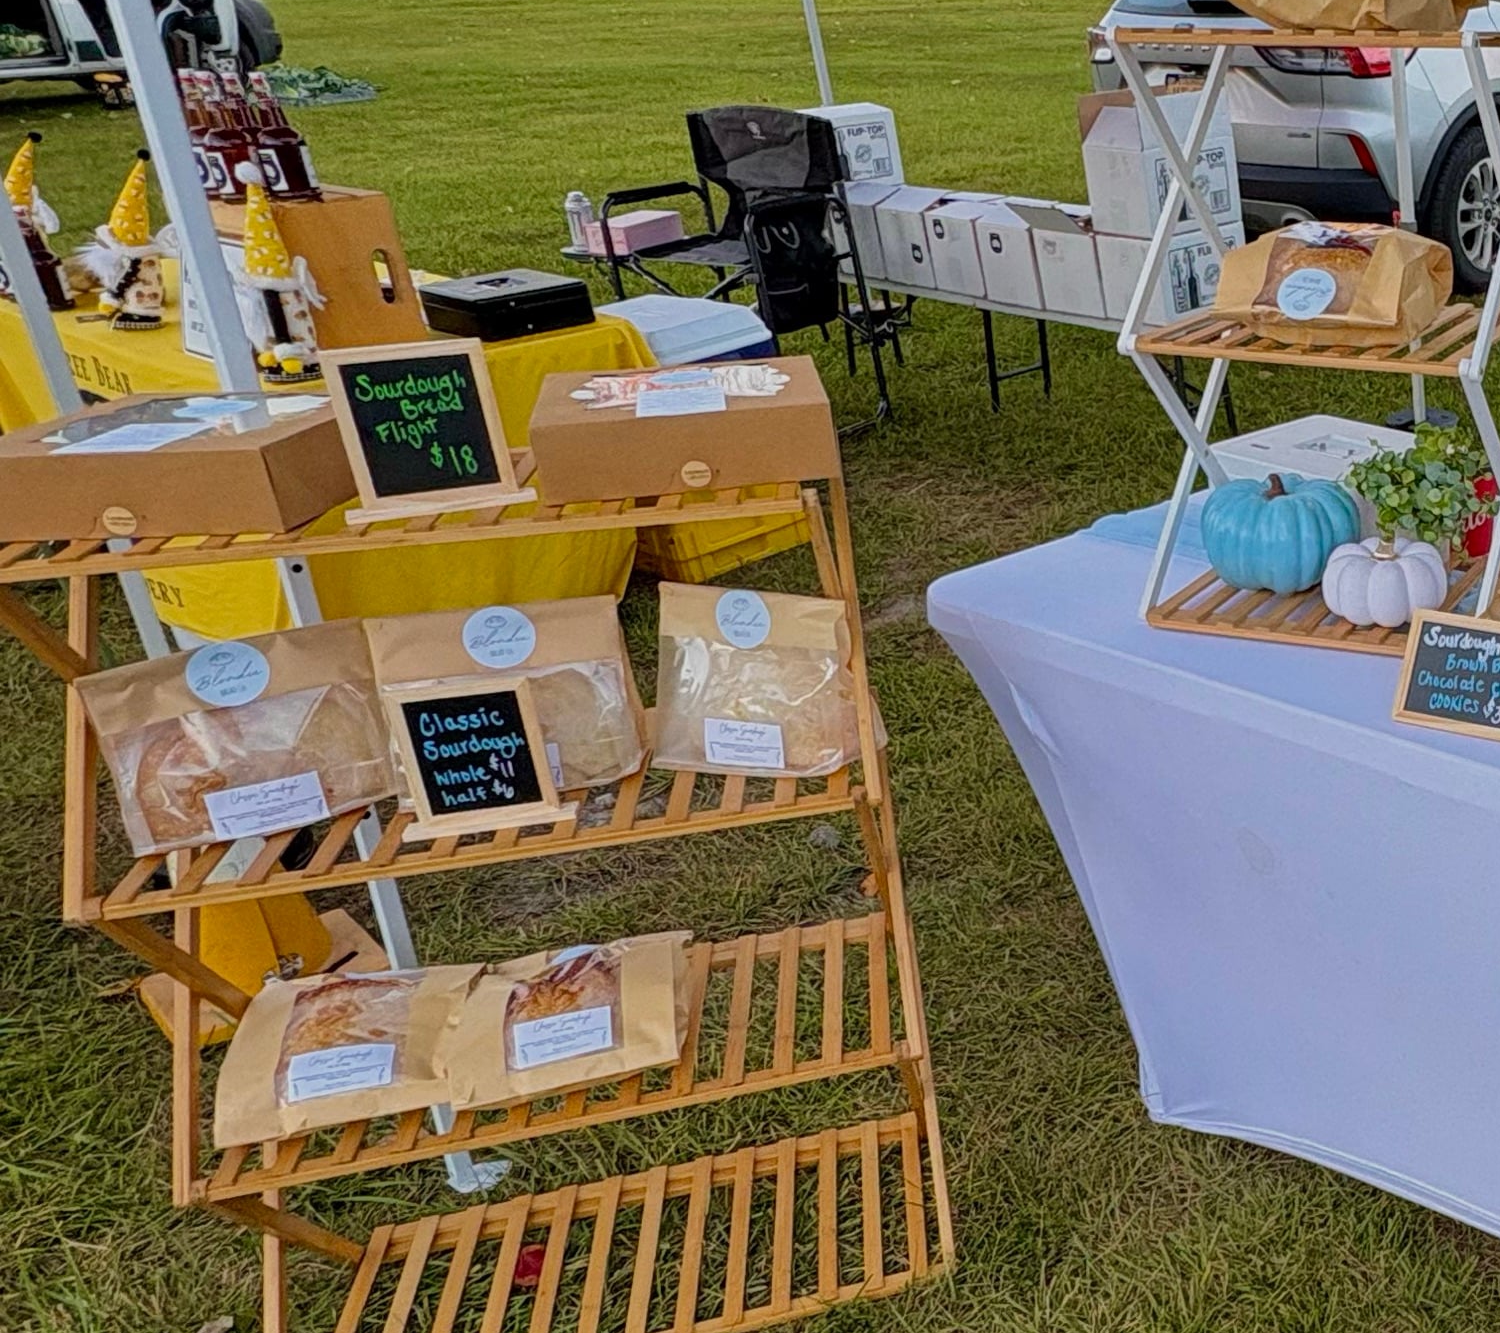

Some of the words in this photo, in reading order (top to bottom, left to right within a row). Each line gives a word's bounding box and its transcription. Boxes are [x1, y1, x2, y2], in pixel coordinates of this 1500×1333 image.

[355, 370, 466, 402] Sourdough
[400, 391, 464, 420] Bread
[375, 417, 438, 449] Flight
[146, 578, 185, 608] ERY
[1446, 653, 1488, 673] Brown
[1418, 670, 1485, 693] Chocolate
[420, 707, 504, 737] Classic
[423, 732, 525, 761] Sourdough
[489, 753, 515, 778] $11
[441, 786, 487, 807] half
